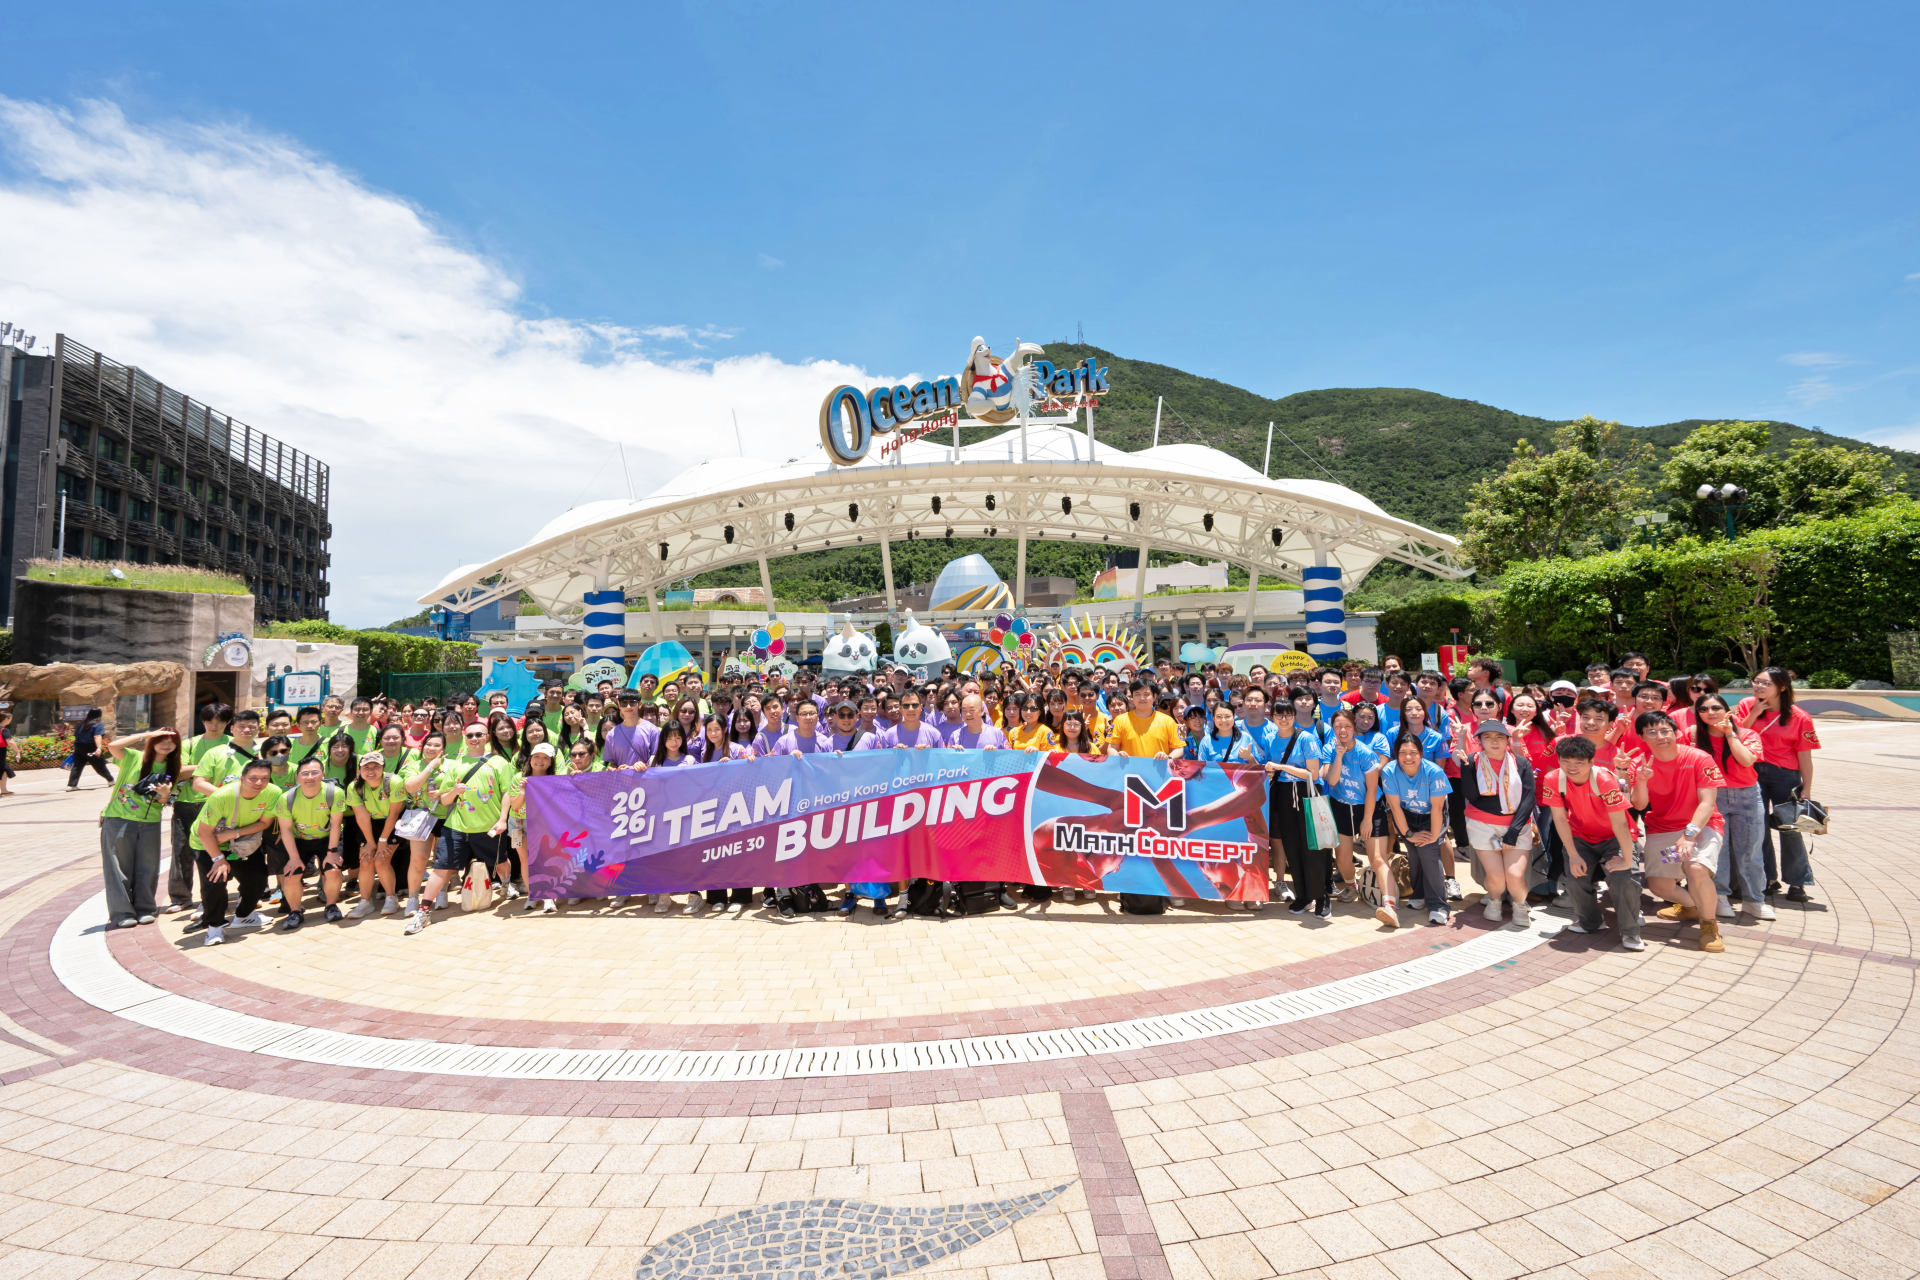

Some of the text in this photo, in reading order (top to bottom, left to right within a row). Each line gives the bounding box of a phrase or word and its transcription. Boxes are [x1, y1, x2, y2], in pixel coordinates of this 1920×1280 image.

[820, 357, 1111, 466] Ocean Park
[881, 412, 958, 459] Hong Kong
[610, 787, 646, 816] 20
[662, 778, 793, 845] TEAM
[797, 765, 969, 812] @ Hong Kong Ocean Park
[610, 809, 647, 839] 26
[775, 777, 1020, 862] BUILDING
[701, 836, 765, 863] JUNE 30
